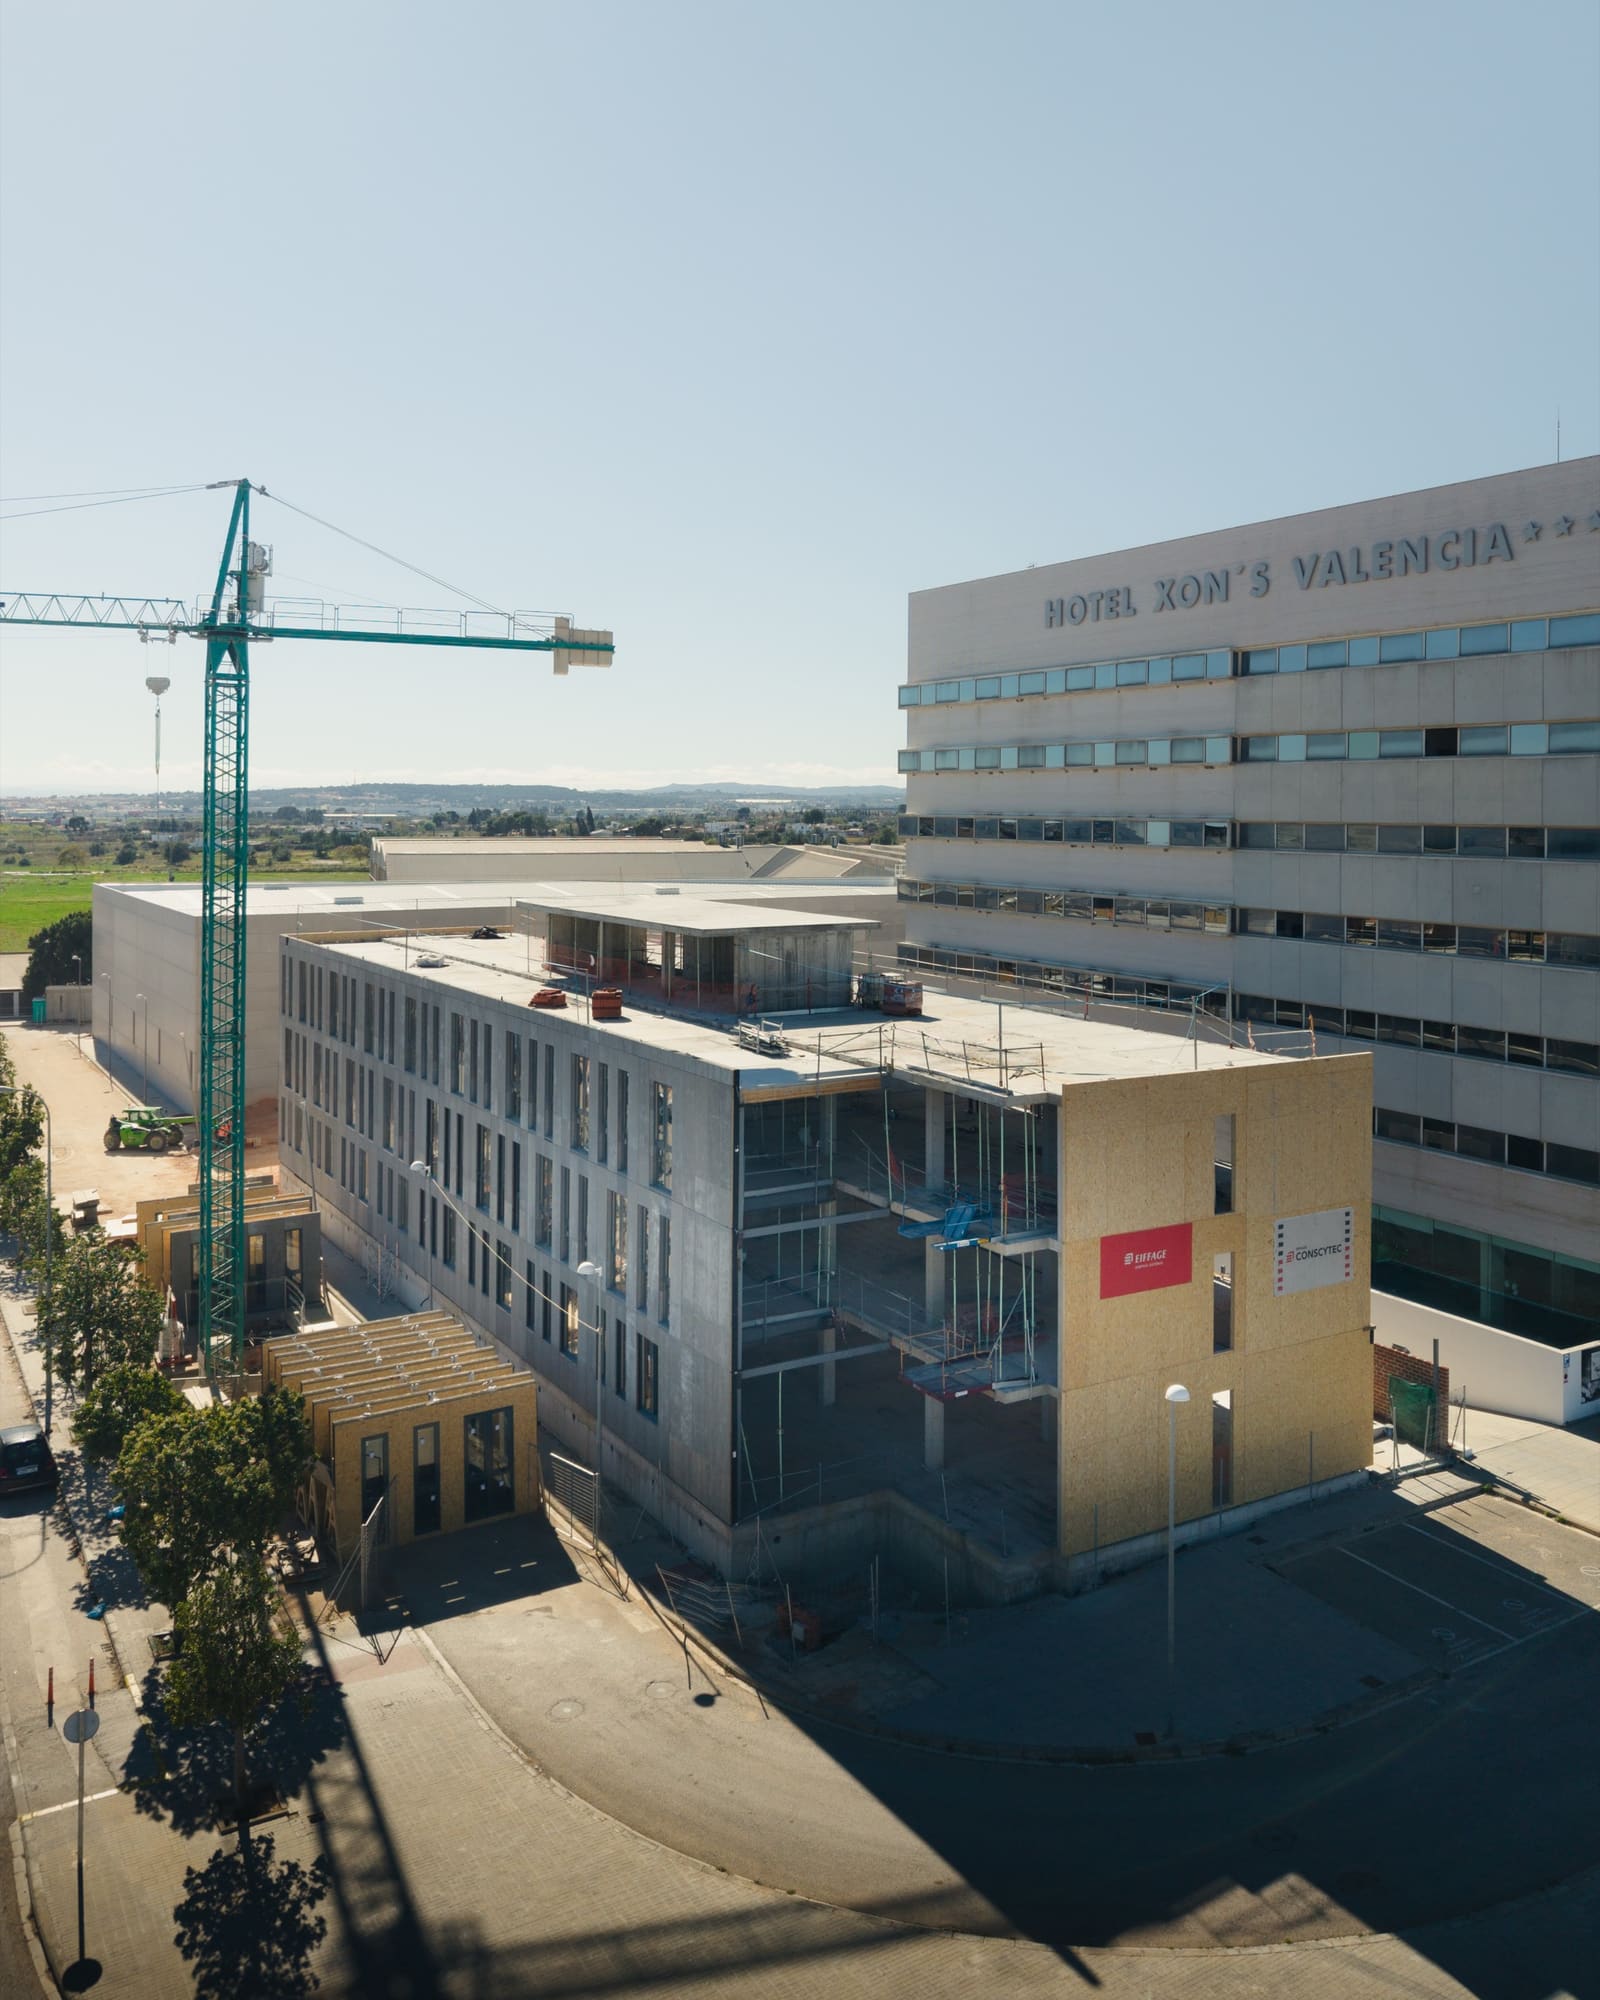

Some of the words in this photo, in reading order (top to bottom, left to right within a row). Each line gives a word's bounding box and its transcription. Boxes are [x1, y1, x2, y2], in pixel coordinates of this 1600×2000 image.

[1044, 586, 1137, 629] HOTEL
[1291, 521, 1515, 590] VALENCIA
[1134, 1249, 1168, 1264] EIFFAGE
[1295, 1243, 1343, 1261] CONSCYTEC
